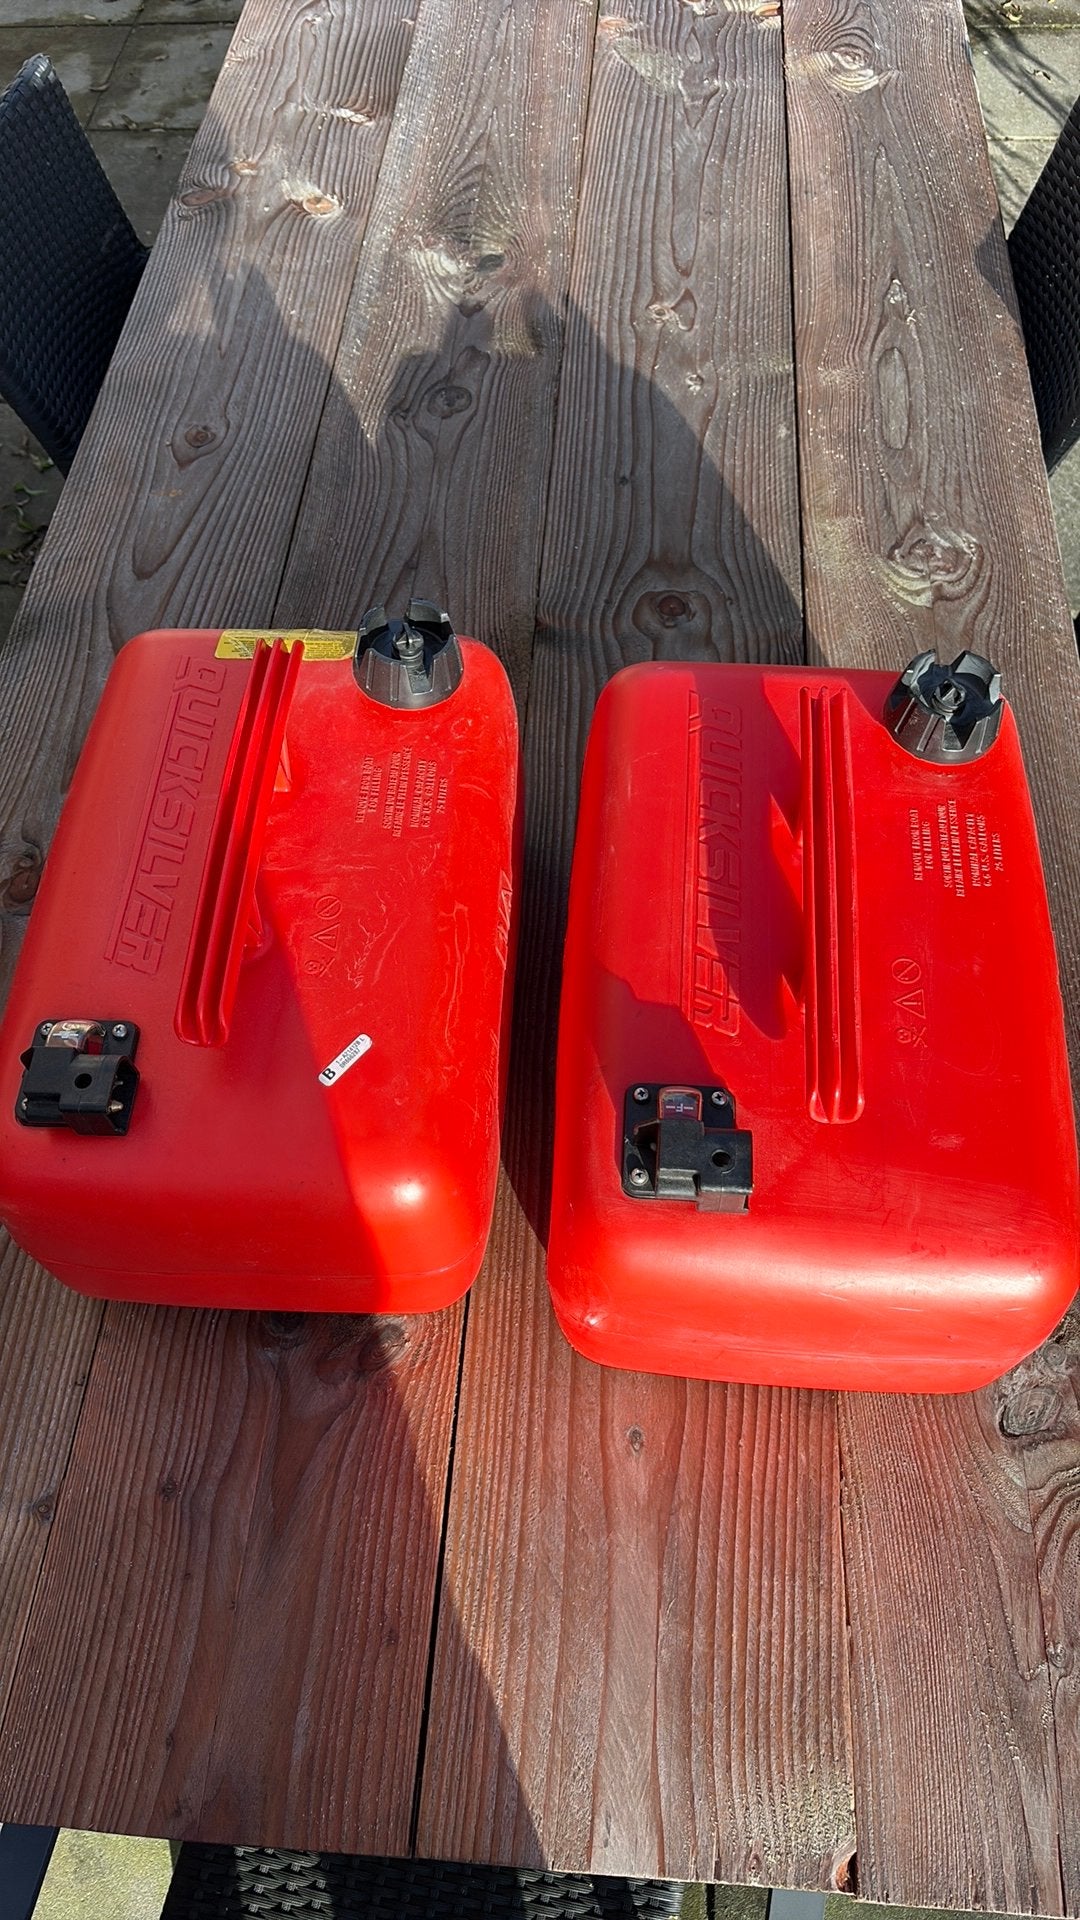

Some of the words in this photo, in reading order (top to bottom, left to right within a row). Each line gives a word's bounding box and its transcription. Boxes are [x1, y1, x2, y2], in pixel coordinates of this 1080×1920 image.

[363, 757, 373, 774] BOAT
[415, 760, 428, 793] CAPACITY
[425, 760, 439, 795] GALLONS
[360, 775, 371, 794] FROM
[371, 766, 383, 795] FILLING
[438, 777, 450, 803] LITERS
[110, 655, 227, 976] QUICKSILVER
[357, 794, 368, 822] REMOVE
[368, 797, 379, 812] FOR
[411, 795, 423, 827] NOMINAL
[423, 798, 434, 813] U.S.
[436, 803, 446, 814] 25
[421, 815, 432, 827] 6.6
[909, 809, 919, 828] BOAT
[966, 812, 978, 849] CAPACITY
[911, 829, 921, 849] FROM
[921, 820, 933, 851] FILLING
[977, 814, 989, 852] GALLONS
[992, 832, 1004, 860] LITERS
[688, 688, 742, 1037] QUICKSILVER
[913, 851, 924, 880] REMOVE
[924, 852, 935, 869] FOR
[970, 852, 981, 886] NOMINAL
[981, 853, 991, 871] U.S.
[994, 861, 1005, 871] 25
[982, 872, 992, 887] 6.6
[322, 1068, 336, 1080] B
